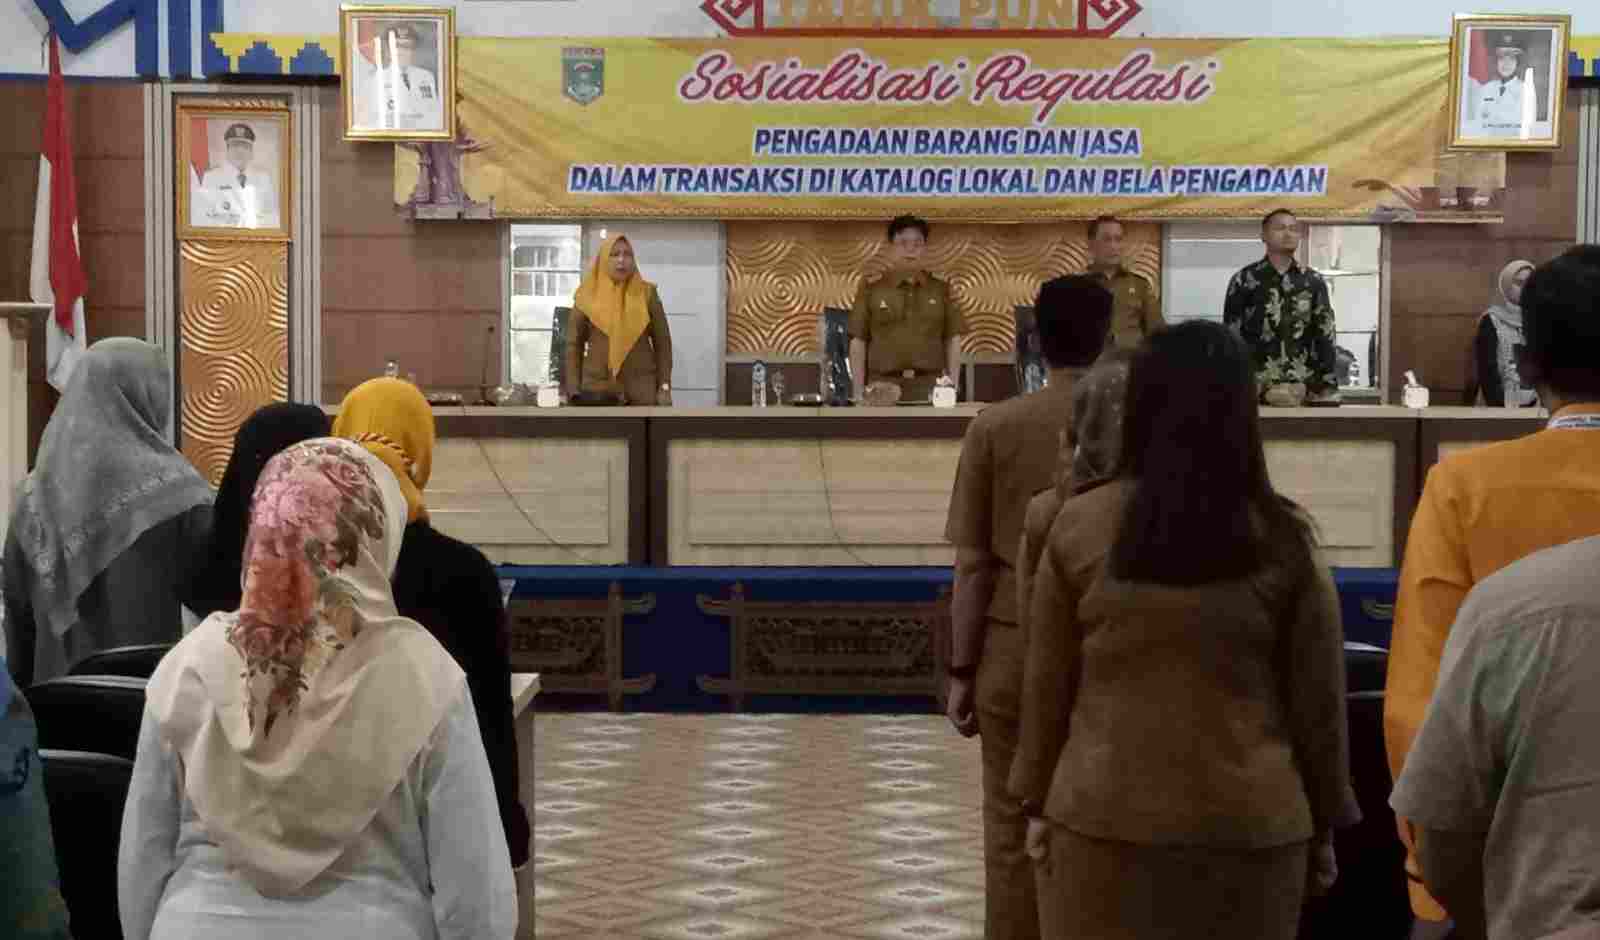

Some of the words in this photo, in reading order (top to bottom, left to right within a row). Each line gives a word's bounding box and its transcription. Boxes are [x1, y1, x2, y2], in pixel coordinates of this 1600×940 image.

[679, 52, 967, 101] Sosialisasi
[972, 52, 1217, 123] Regulasi
[754, 128, 909, 154] PENGADAAN
[914, 128, 1018, 154] BARANG
[1022, 129, 1076, 154] DAN
[1079, 129, 1140, 157] JASA
[569, 166, 657, 193] DALAM
[661, 166, 802, 193] TRANSAKSI
[808, 168, 834, 193] DI
[839, 168, 953, 193] KATALOG
[958, 168, 1040, 193] LOKAL
[1044, 168, 1097, 193] DAN
[1101, 168, 1165, 193] BELA
[1169, 167, 1326, 193] PENGADAAN
